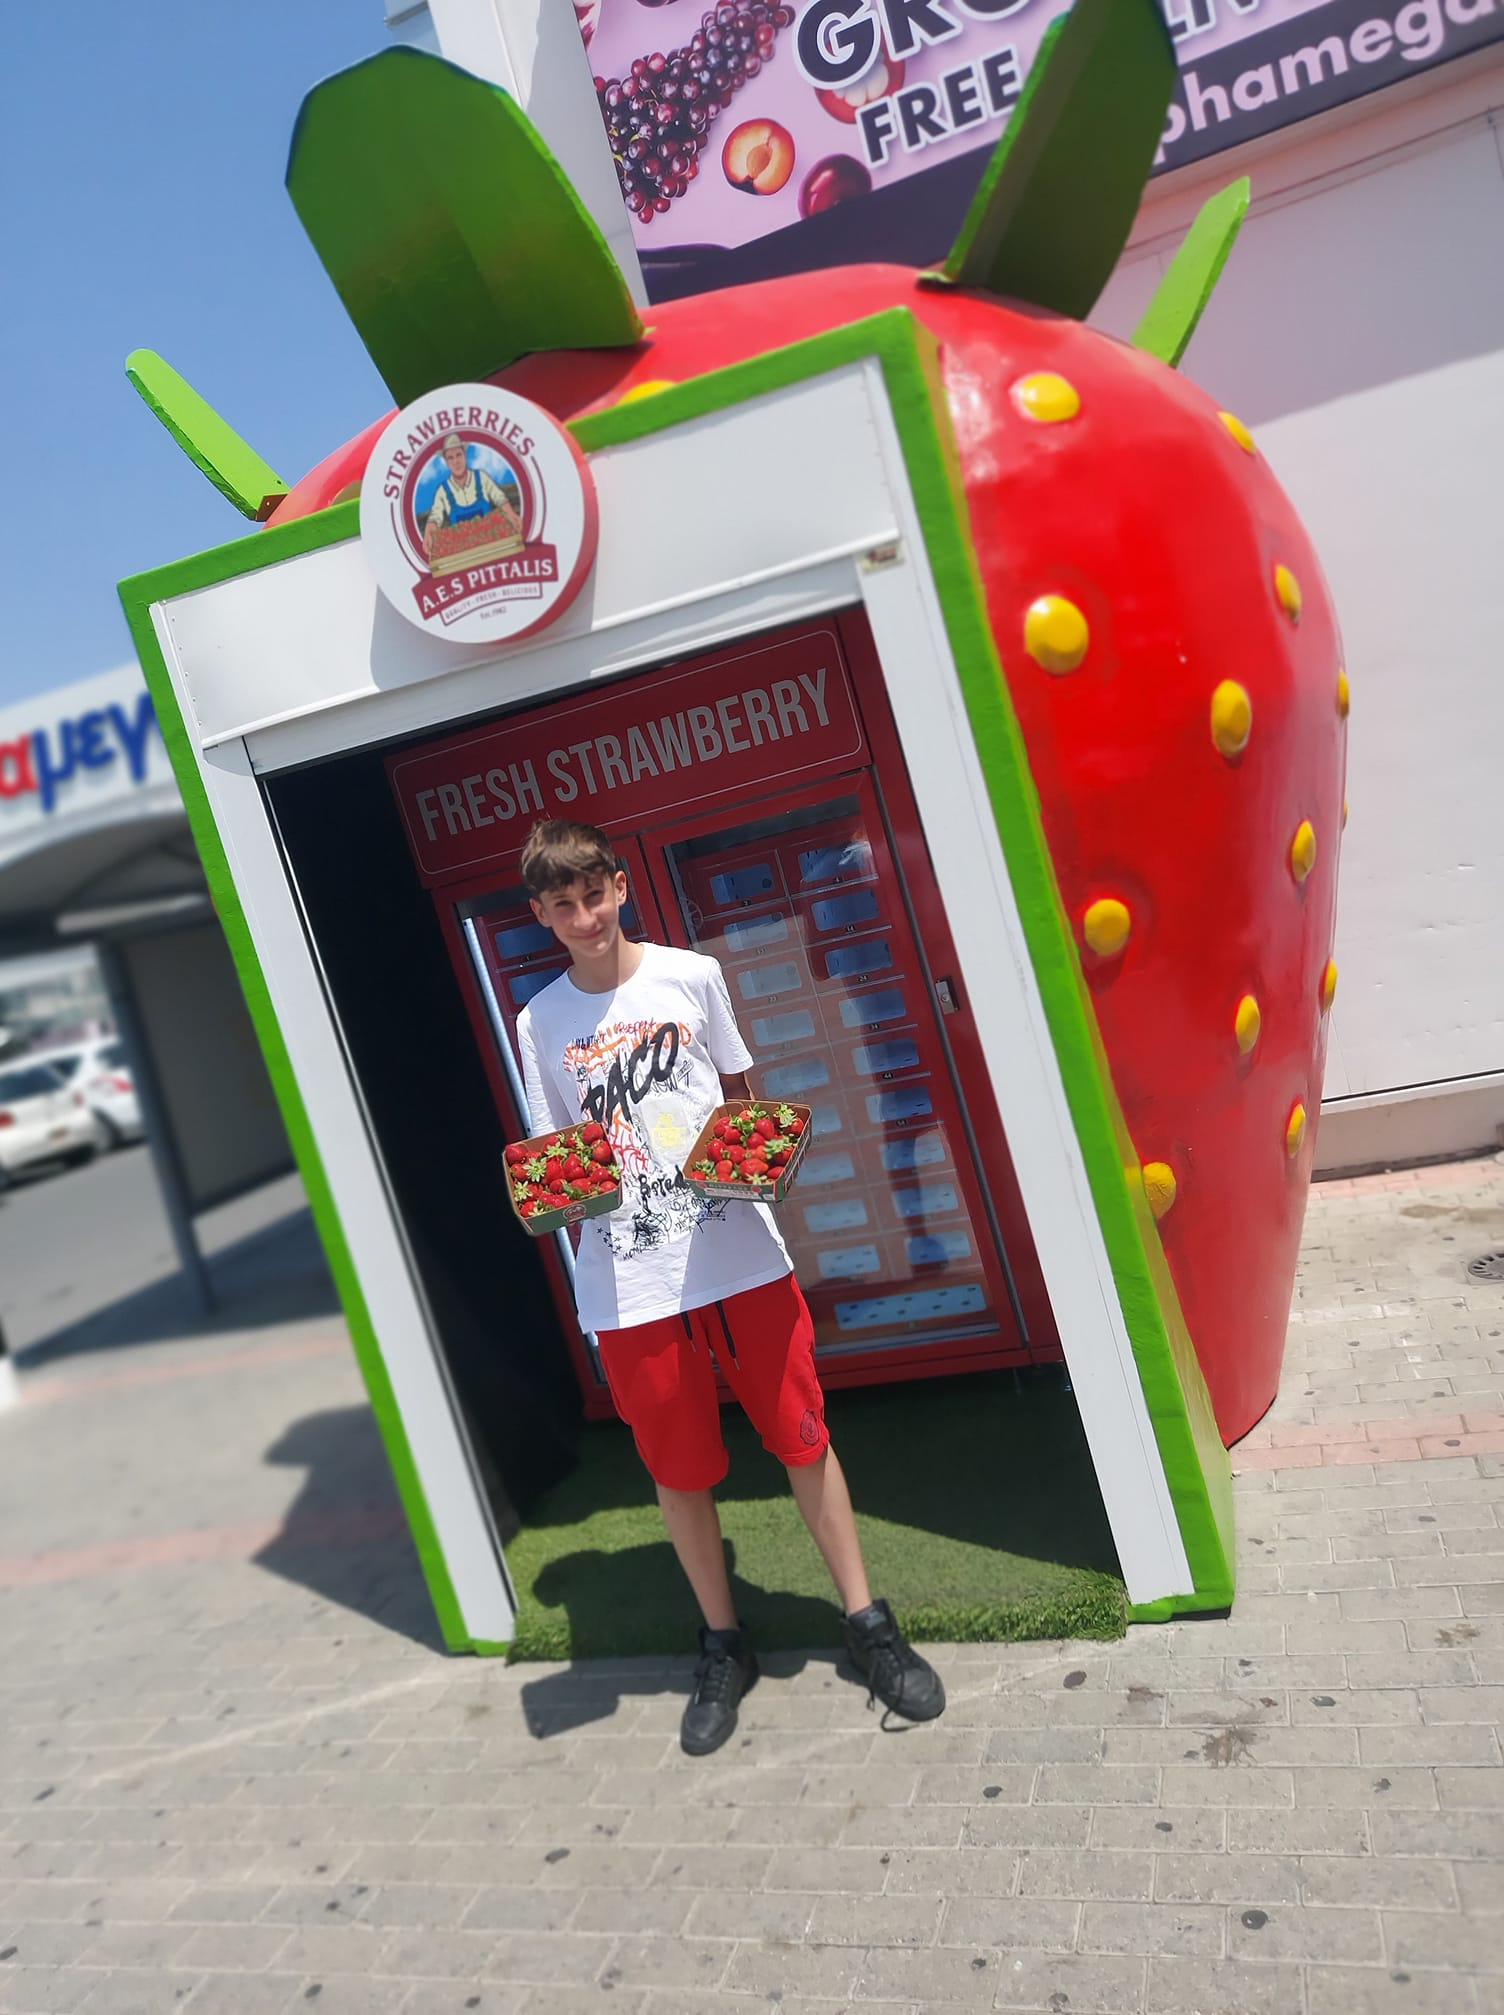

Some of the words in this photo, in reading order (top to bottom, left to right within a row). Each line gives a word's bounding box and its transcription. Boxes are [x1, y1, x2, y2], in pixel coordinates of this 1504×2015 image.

[859, 49, 1020, 164] FREE
[384, 406, 536, 500] STRAWBERRIES
[467, 558, 554, 588] PITTALIS
[415, 758, 545, 842] FRESH
[546, 667, 833, 803] STRAWBERRY
